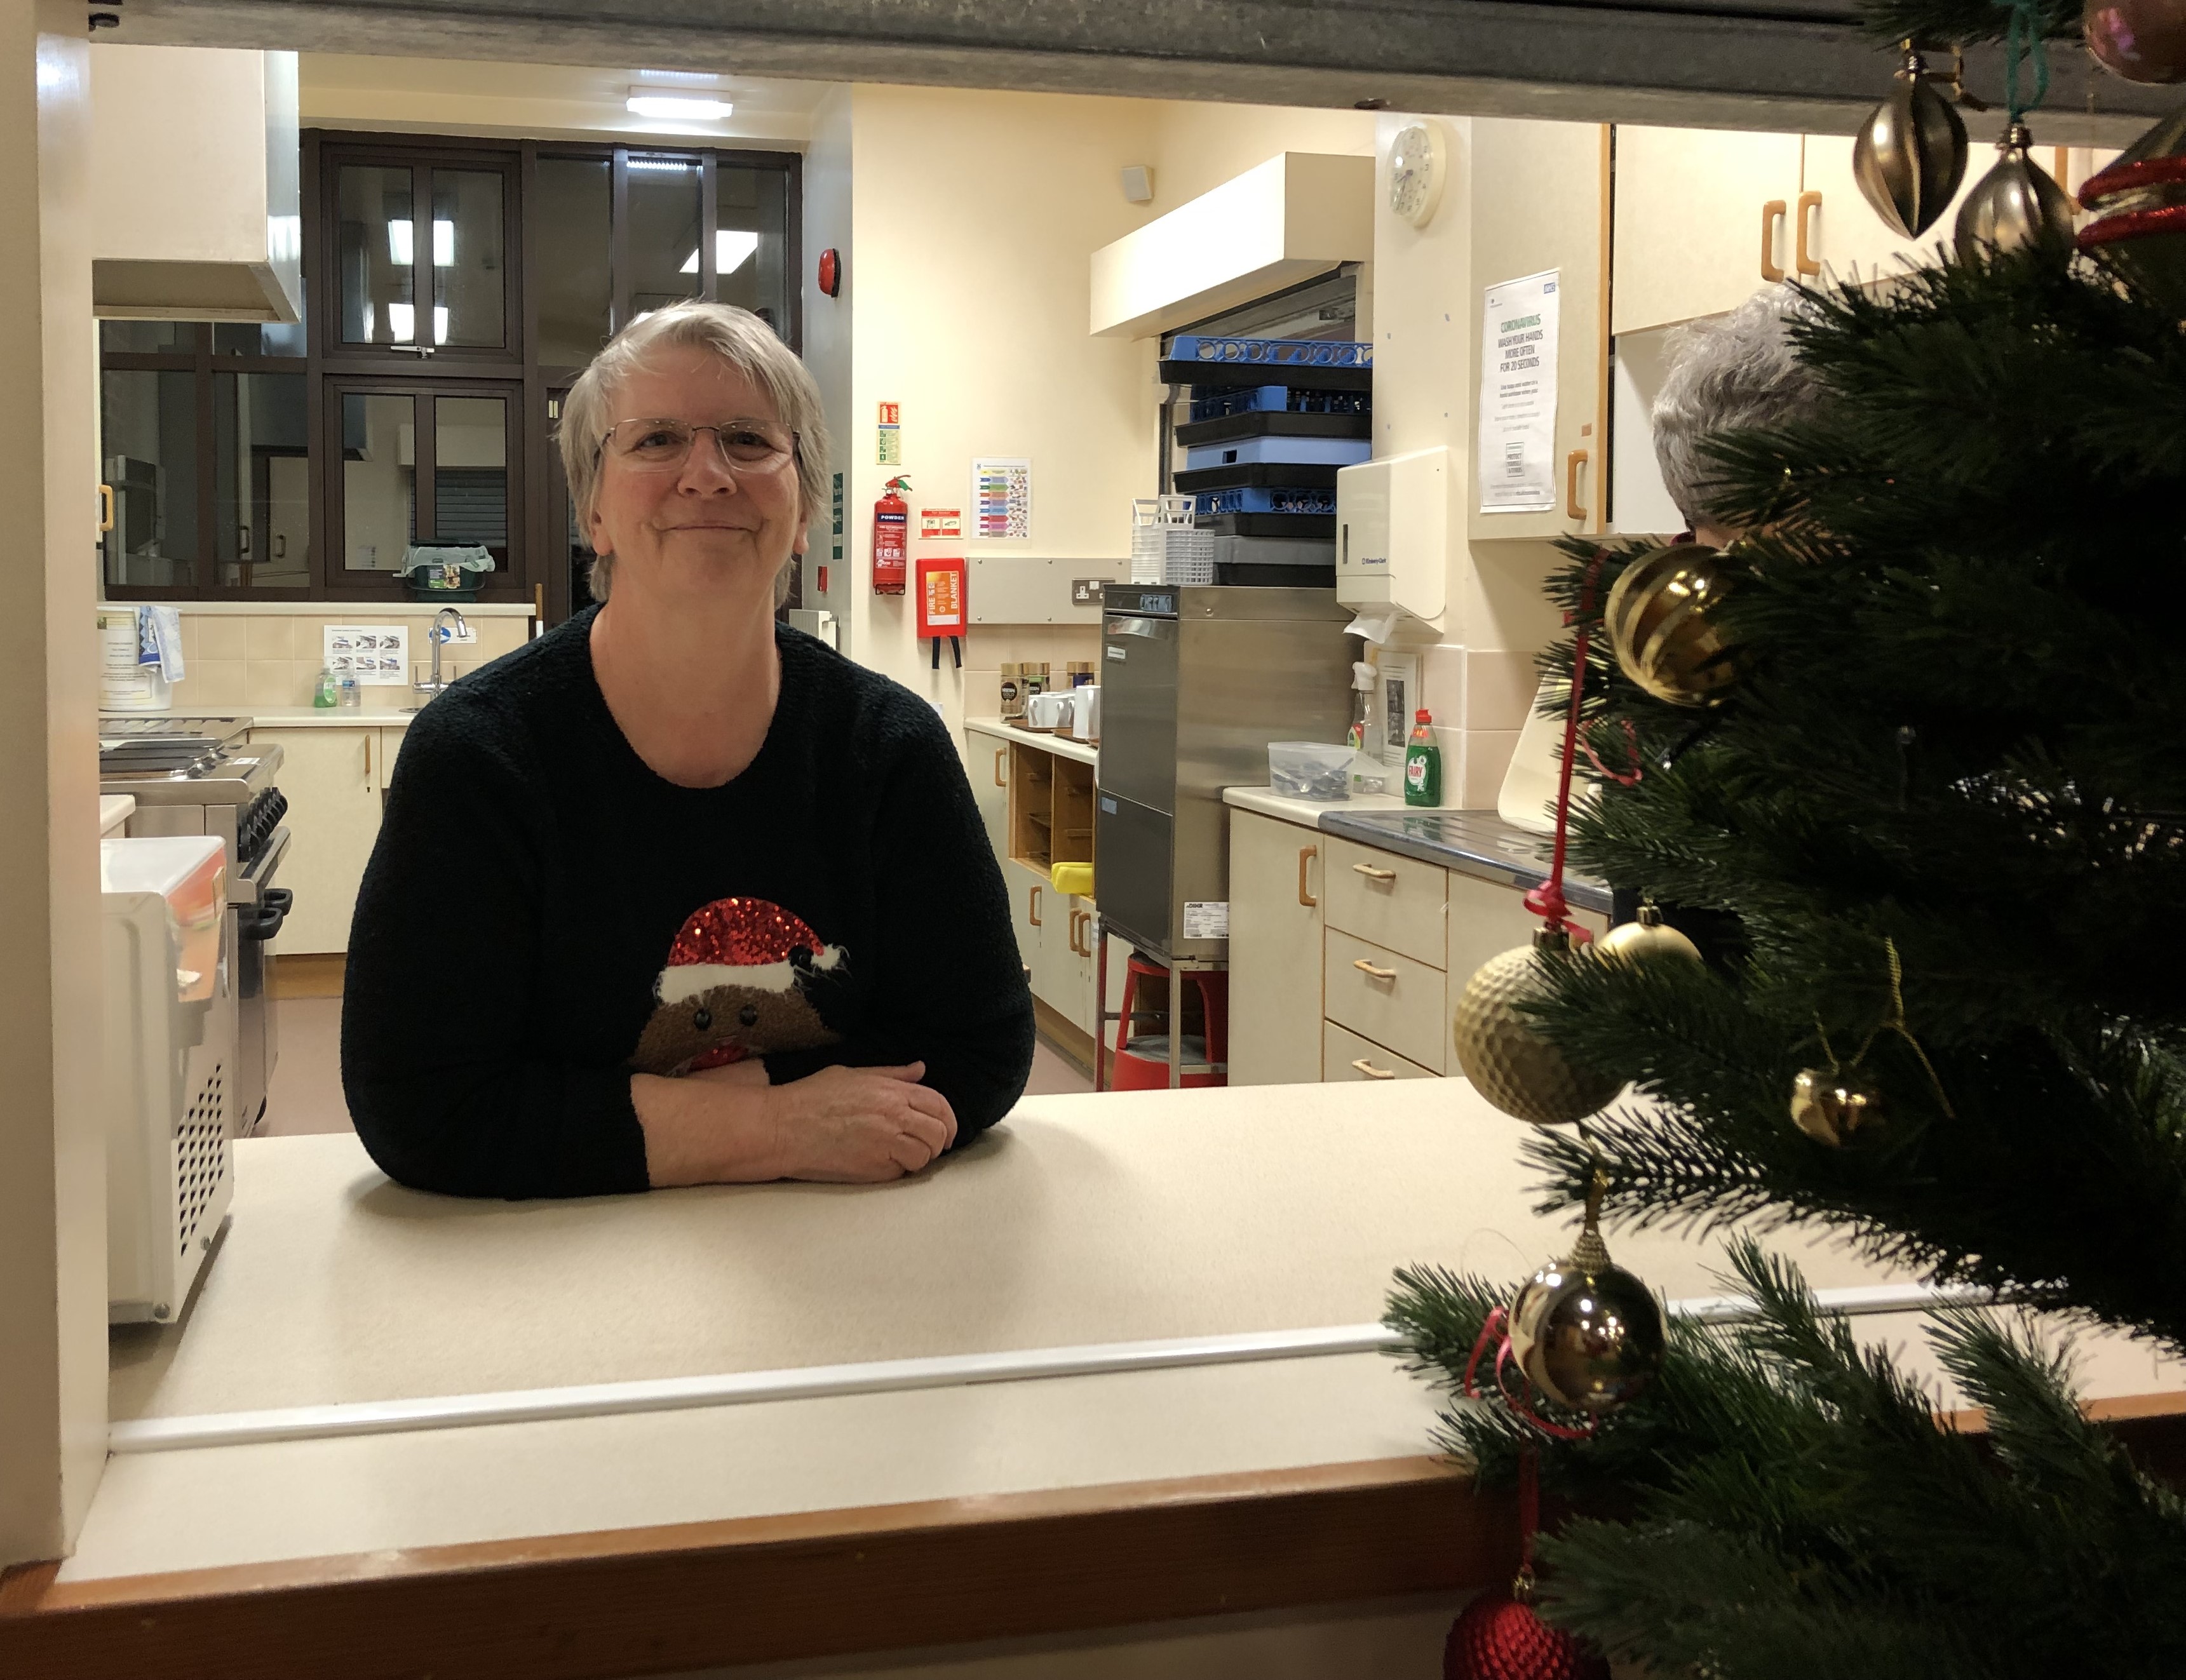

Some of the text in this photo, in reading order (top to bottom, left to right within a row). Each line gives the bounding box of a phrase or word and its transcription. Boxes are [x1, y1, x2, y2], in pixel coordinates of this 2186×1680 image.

[1501, 314, 1541, 333] CORONAVIRUS
[1498, 330, 1543, 348] WASH YOUR HANDS
[1505, 345, 1535, 359] MORE OFTEN
[1500, 356, 1540, 372] FOR 20 SECONDS
[950, 572, 958, 609] BLANKET
[1408, 765, 1423, 777] FAIRY
